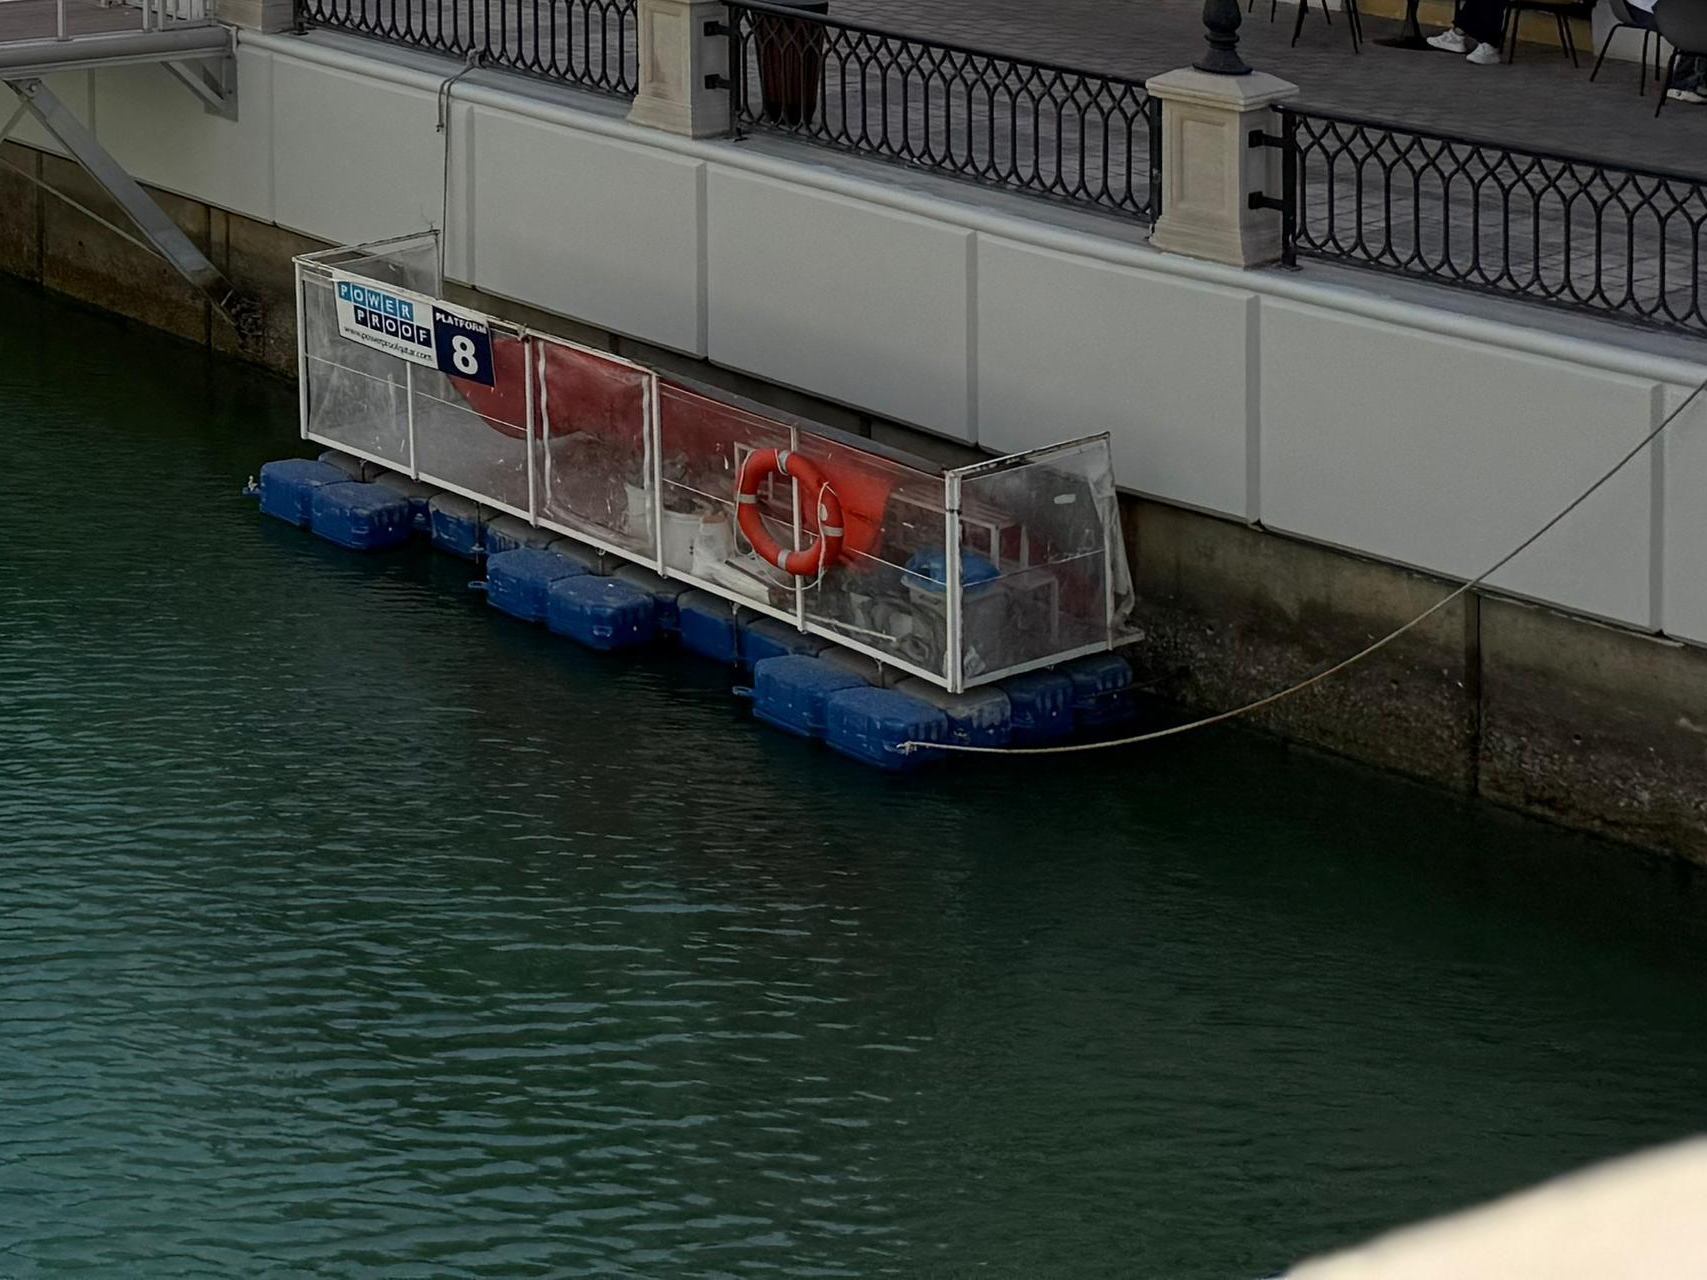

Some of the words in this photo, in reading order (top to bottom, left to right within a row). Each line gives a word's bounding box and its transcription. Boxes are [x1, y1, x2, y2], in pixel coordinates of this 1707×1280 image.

[340, 284, 412, 318] POWER
[356, 311, 428, 342] PROOF
[435, 312, 487, 335] PLATFORM
[452, 335, 479, 375] 8
